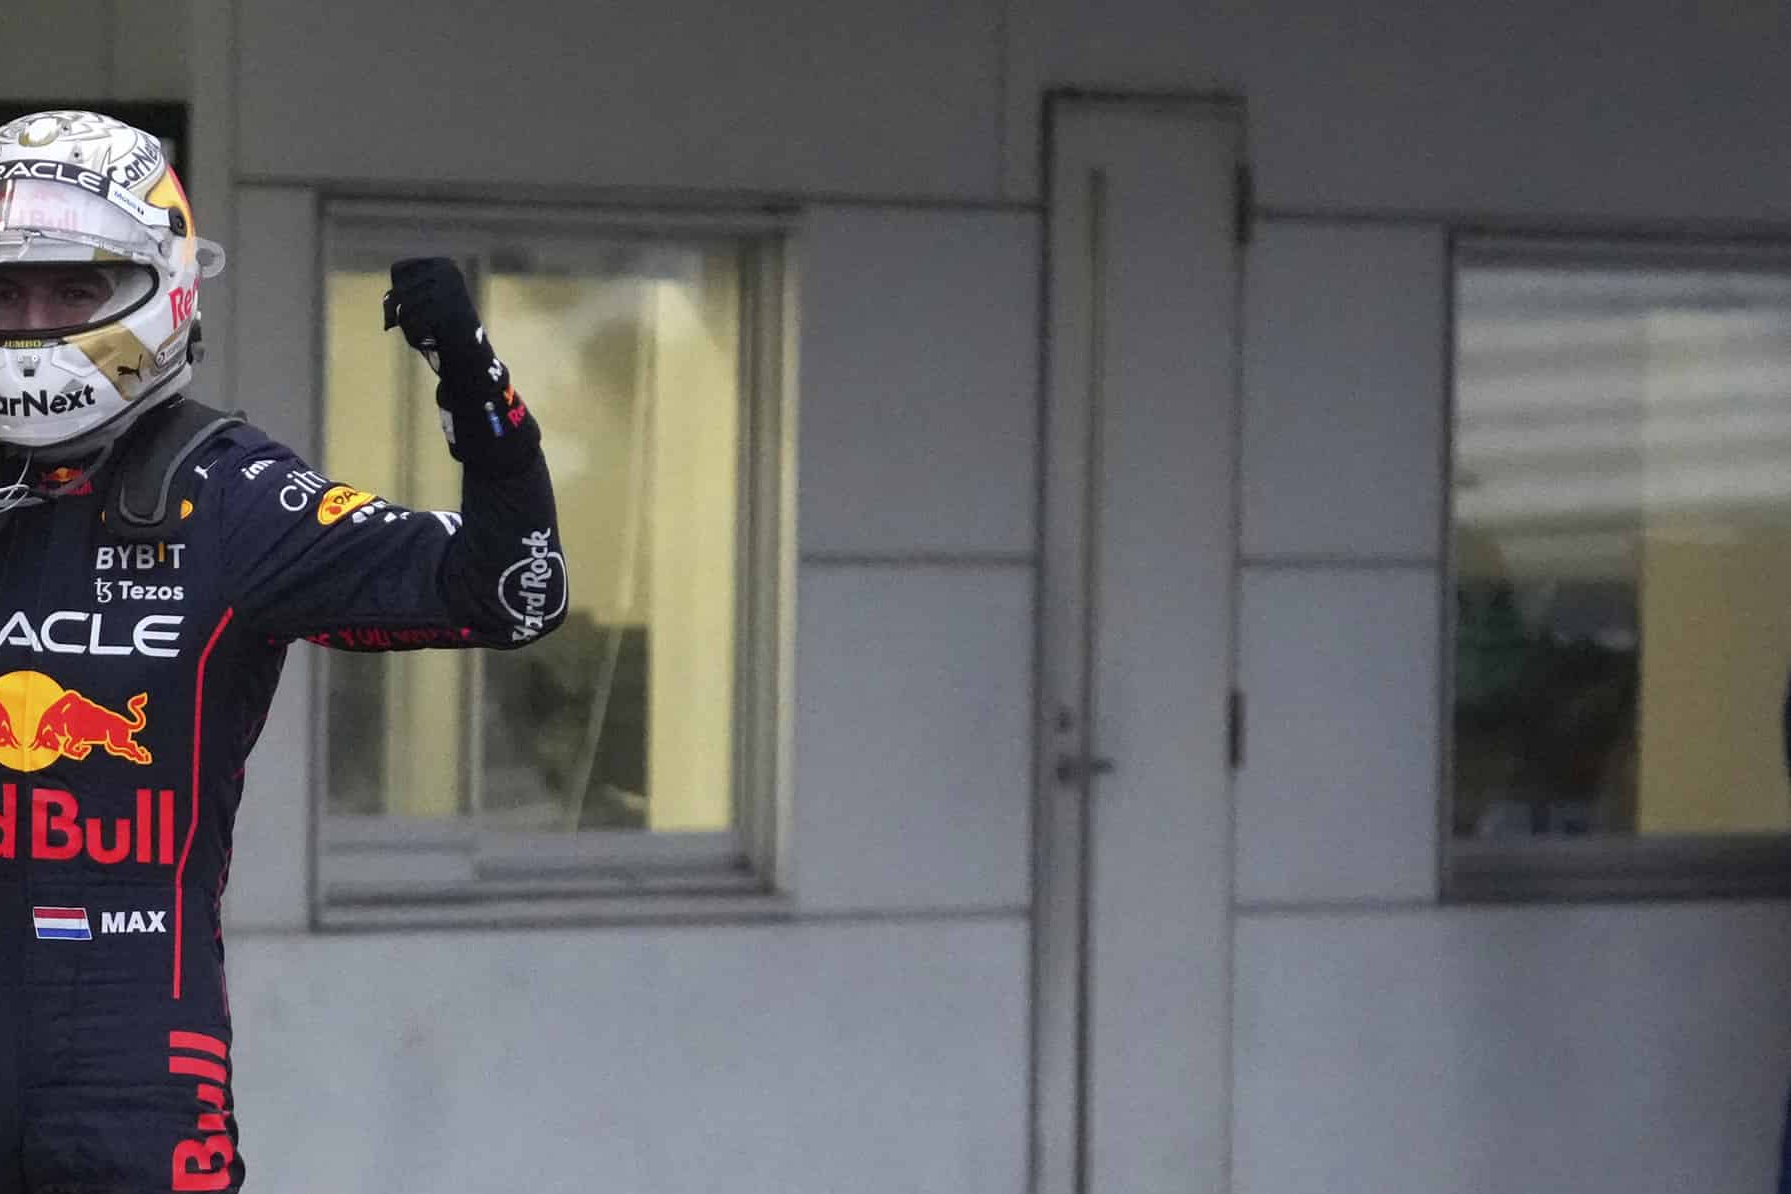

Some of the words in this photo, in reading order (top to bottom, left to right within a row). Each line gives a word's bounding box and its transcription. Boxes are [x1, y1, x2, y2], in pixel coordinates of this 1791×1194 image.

[95, 543, 186, 570] BYBIT
[521, 527, 552, 589] Rock
[118, 580, 185, 600] Tezos
[30, 787, 176, 865] Bull
[100, 911, 167, 935] MAX
[168, 1029, 234, 1192] Bull
